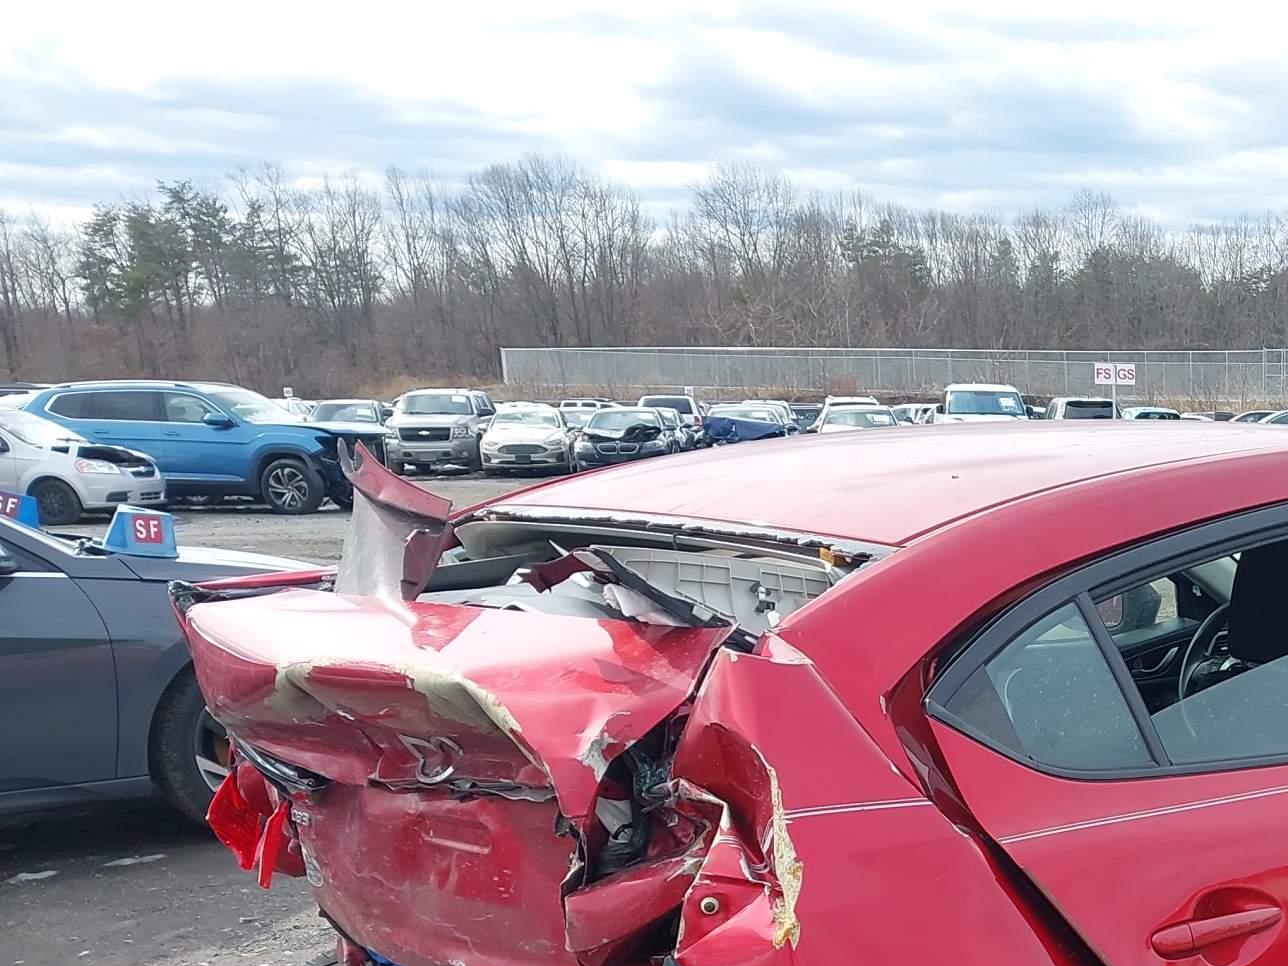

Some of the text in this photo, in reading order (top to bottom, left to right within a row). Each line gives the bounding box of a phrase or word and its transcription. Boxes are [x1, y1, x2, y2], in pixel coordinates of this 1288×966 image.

[1096, 368, 1112, 380] FS
[1117, 368, 1135, 380] GS
[135, 519, 159, 539] SF
